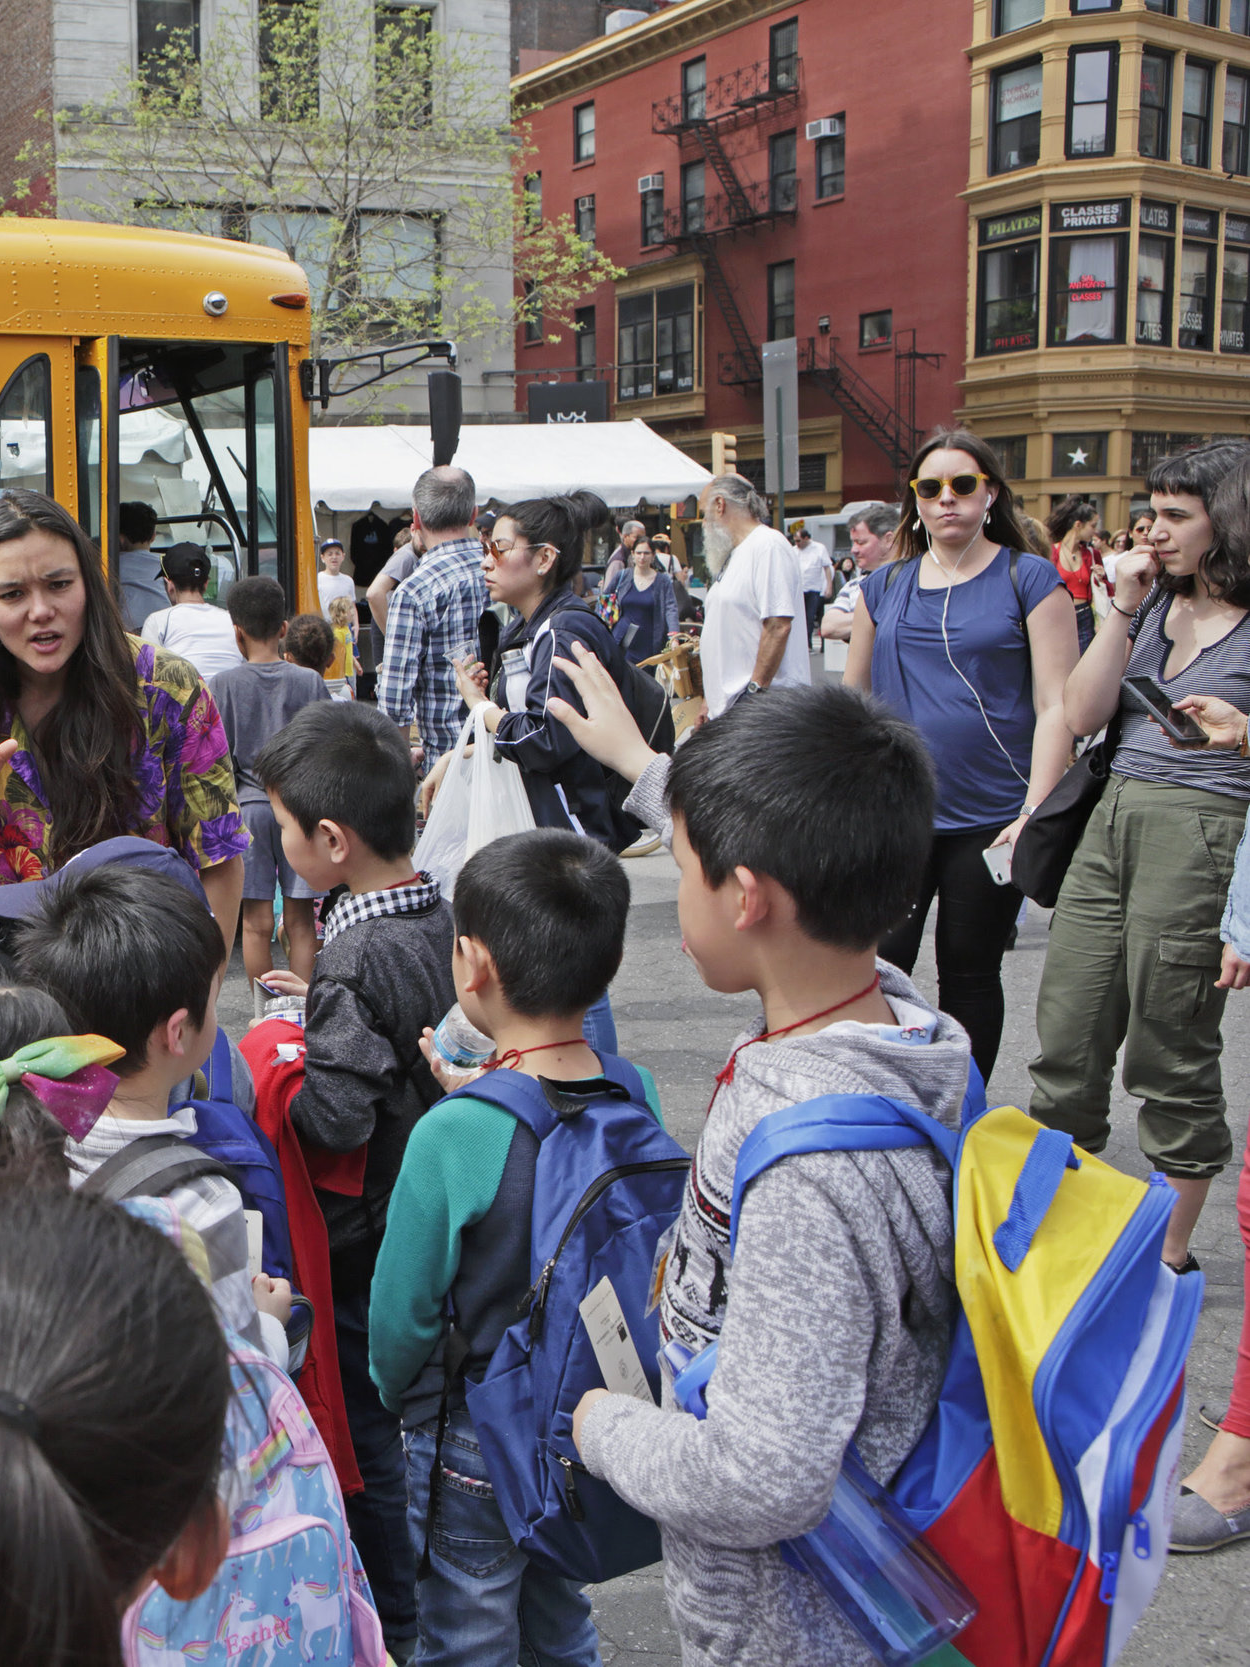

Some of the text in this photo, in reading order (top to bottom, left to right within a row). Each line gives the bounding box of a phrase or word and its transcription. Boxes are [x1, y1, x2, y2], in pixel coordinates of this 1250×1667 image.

[1061, 204, 1120, 218] CLASSES
[988, 215, 1040, 237] PILATES
[1063, 214, 1117, 228] PRIVATES
[1071, 292, 1102, 302] CLASSES
[995, 333, 1031, 348] PILATES
[224, 1616, 292, 1659] Esther
